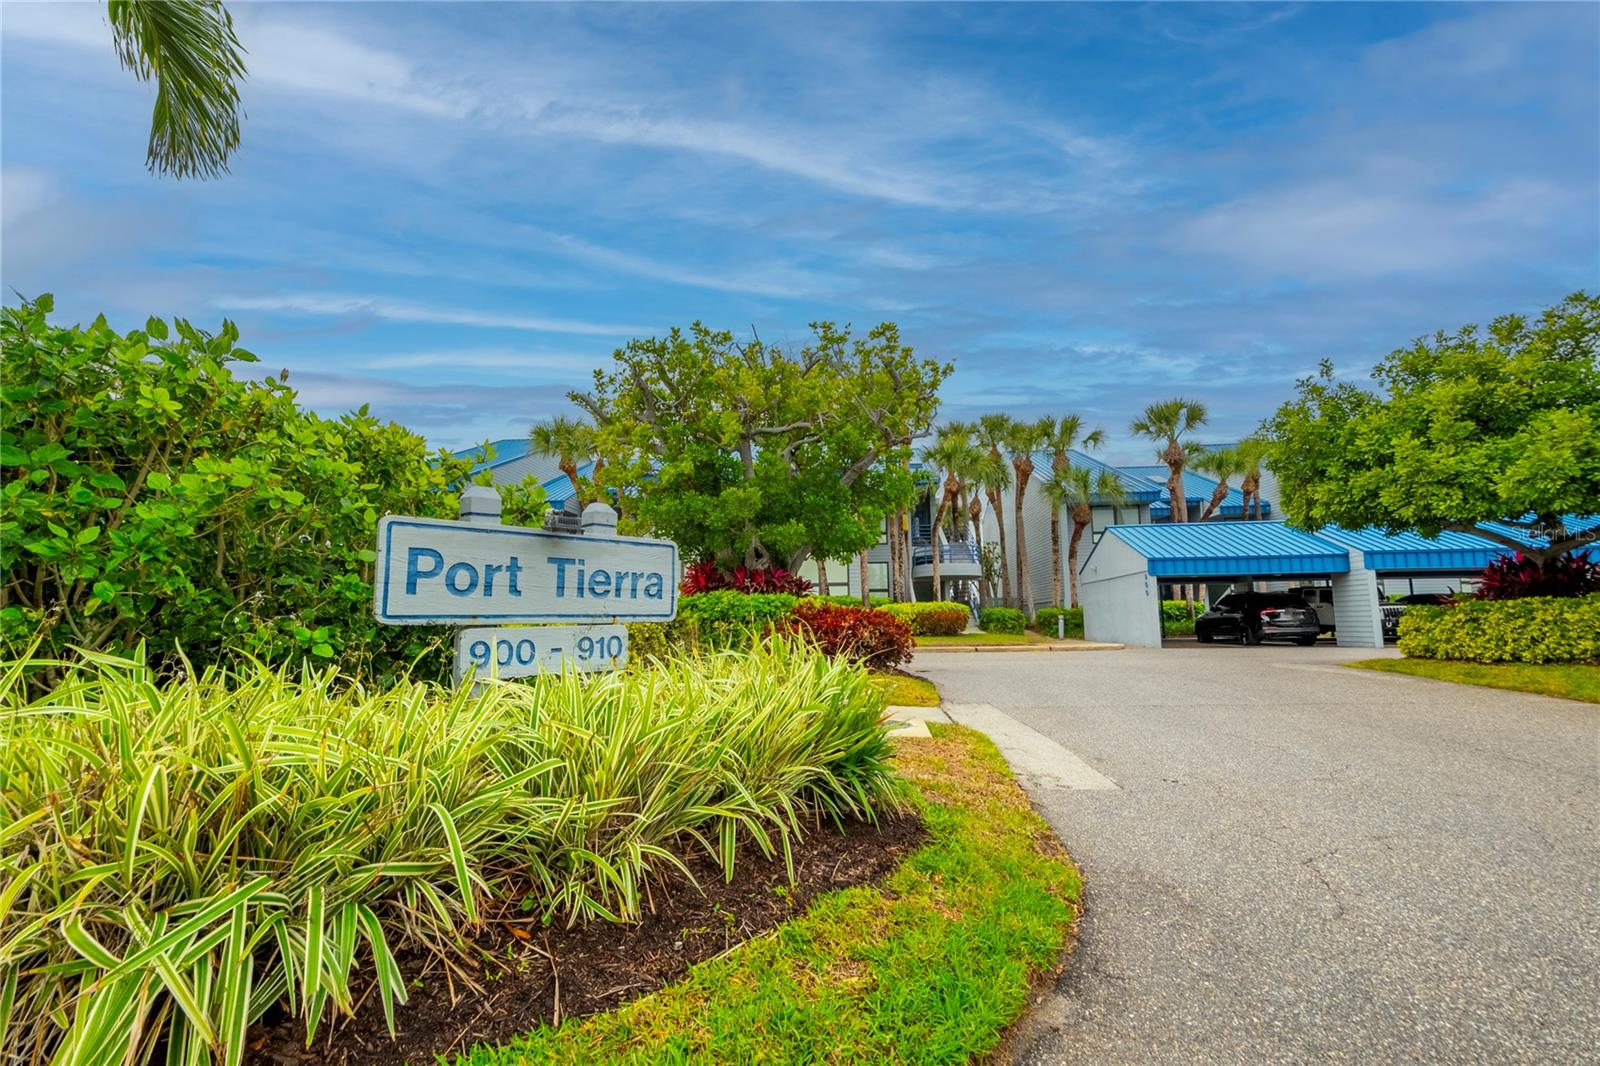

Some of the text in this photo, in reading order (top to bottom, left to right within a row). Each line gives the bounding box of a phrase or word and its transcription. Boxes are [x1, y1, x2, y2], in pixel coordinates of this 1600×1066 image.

[405, 547, 664, 600] Port Tierra
[469, 638, 536, 667] 900
[577, 635, 623, 661] 910
